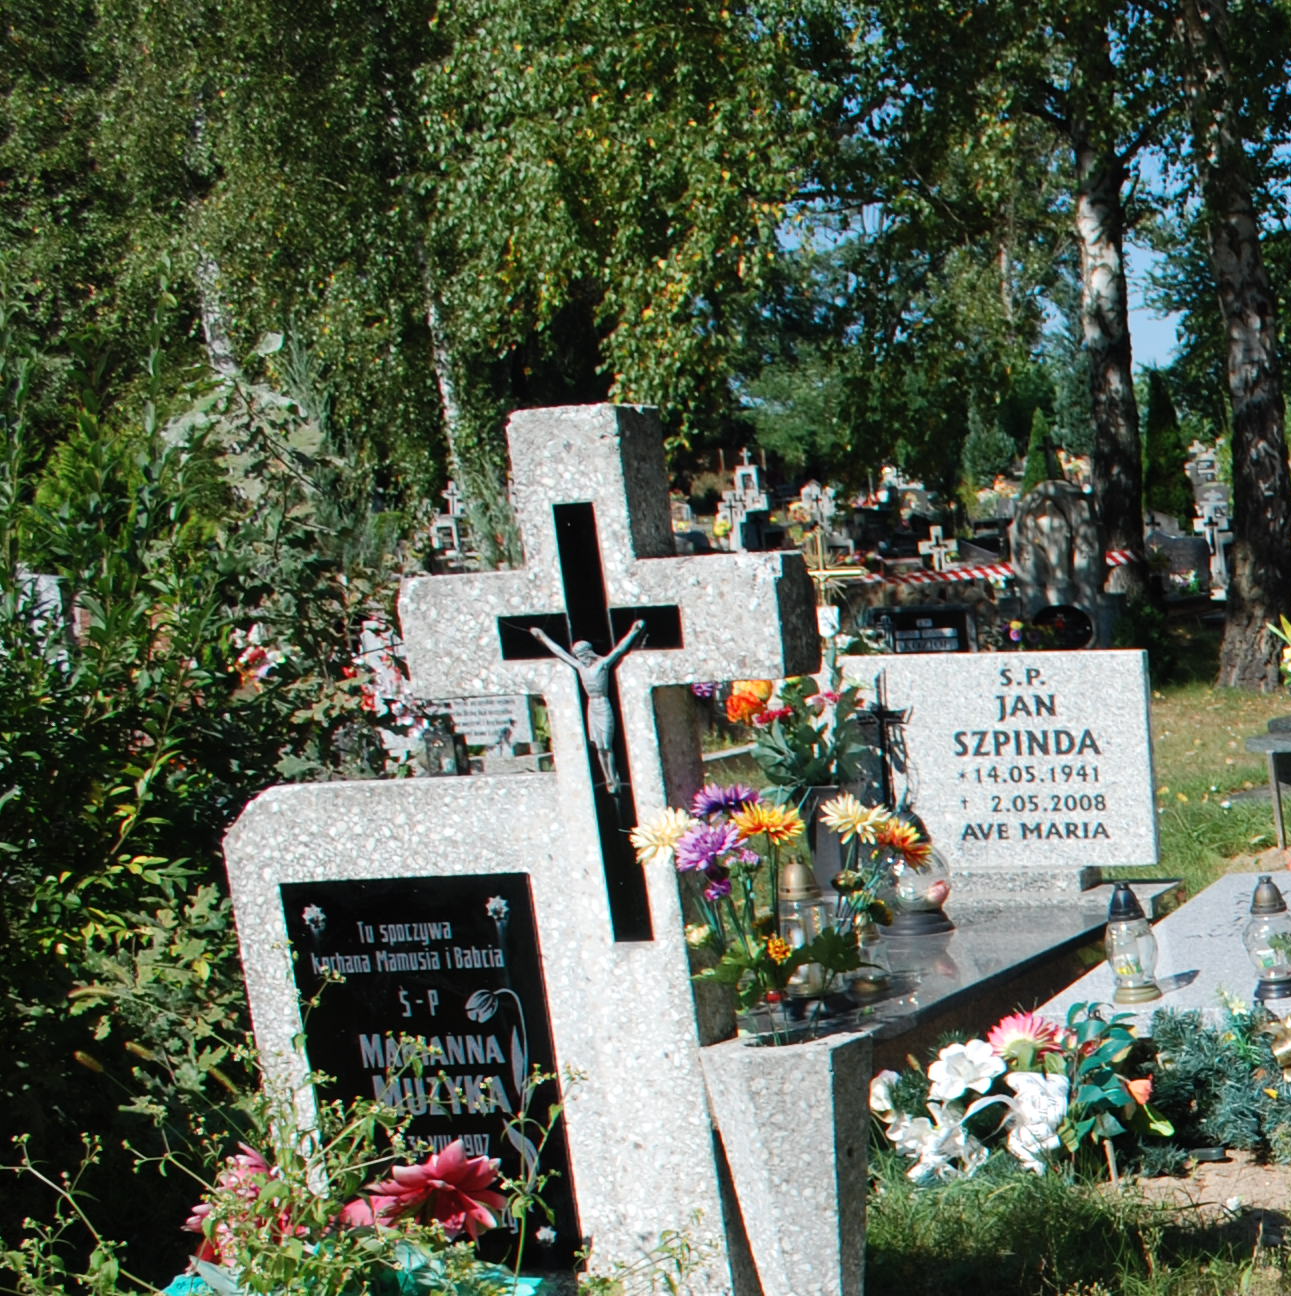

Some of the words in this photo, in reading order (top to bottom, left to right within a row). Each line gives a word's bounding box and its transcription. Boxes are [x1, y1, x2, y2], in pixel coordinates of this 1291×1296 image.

[996, 694, 1058, 722] JAN
[953, 729, 1102, 757] SZPINDA
[961, 823, 1010, 841] AVE
[1020, 821, 1111, 840] MARIA
[357, 920, 375, 944] Tu
[380, 920, 452, 946] spoczywa
[375, 948, 441, 973] Mamusia
[445, 946, 452, 969] i
[454, 944, 505, 969] Babcia
[373, 1075, 513, 1117] MUZYKA
